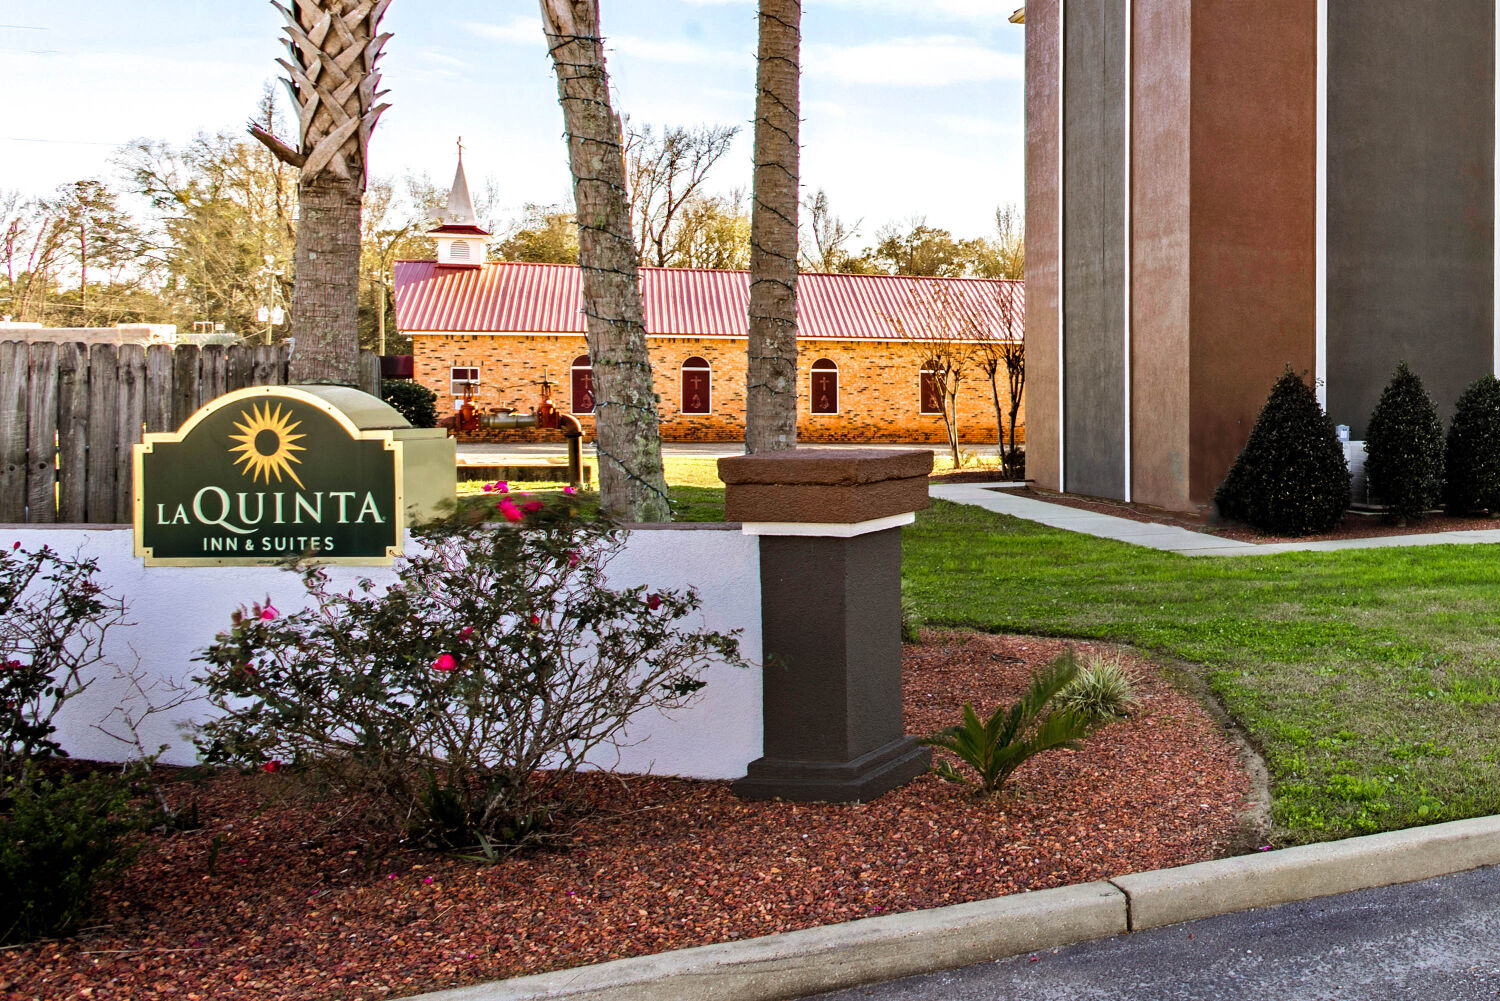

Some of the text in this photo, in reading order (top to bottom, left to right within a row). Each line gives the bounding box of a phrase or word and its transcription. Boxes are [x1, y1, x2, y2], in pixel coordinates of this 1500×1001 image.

[157, 485, 386, 534] LA QUINTA
[203, 536, 334, 551] INN & SUITES
